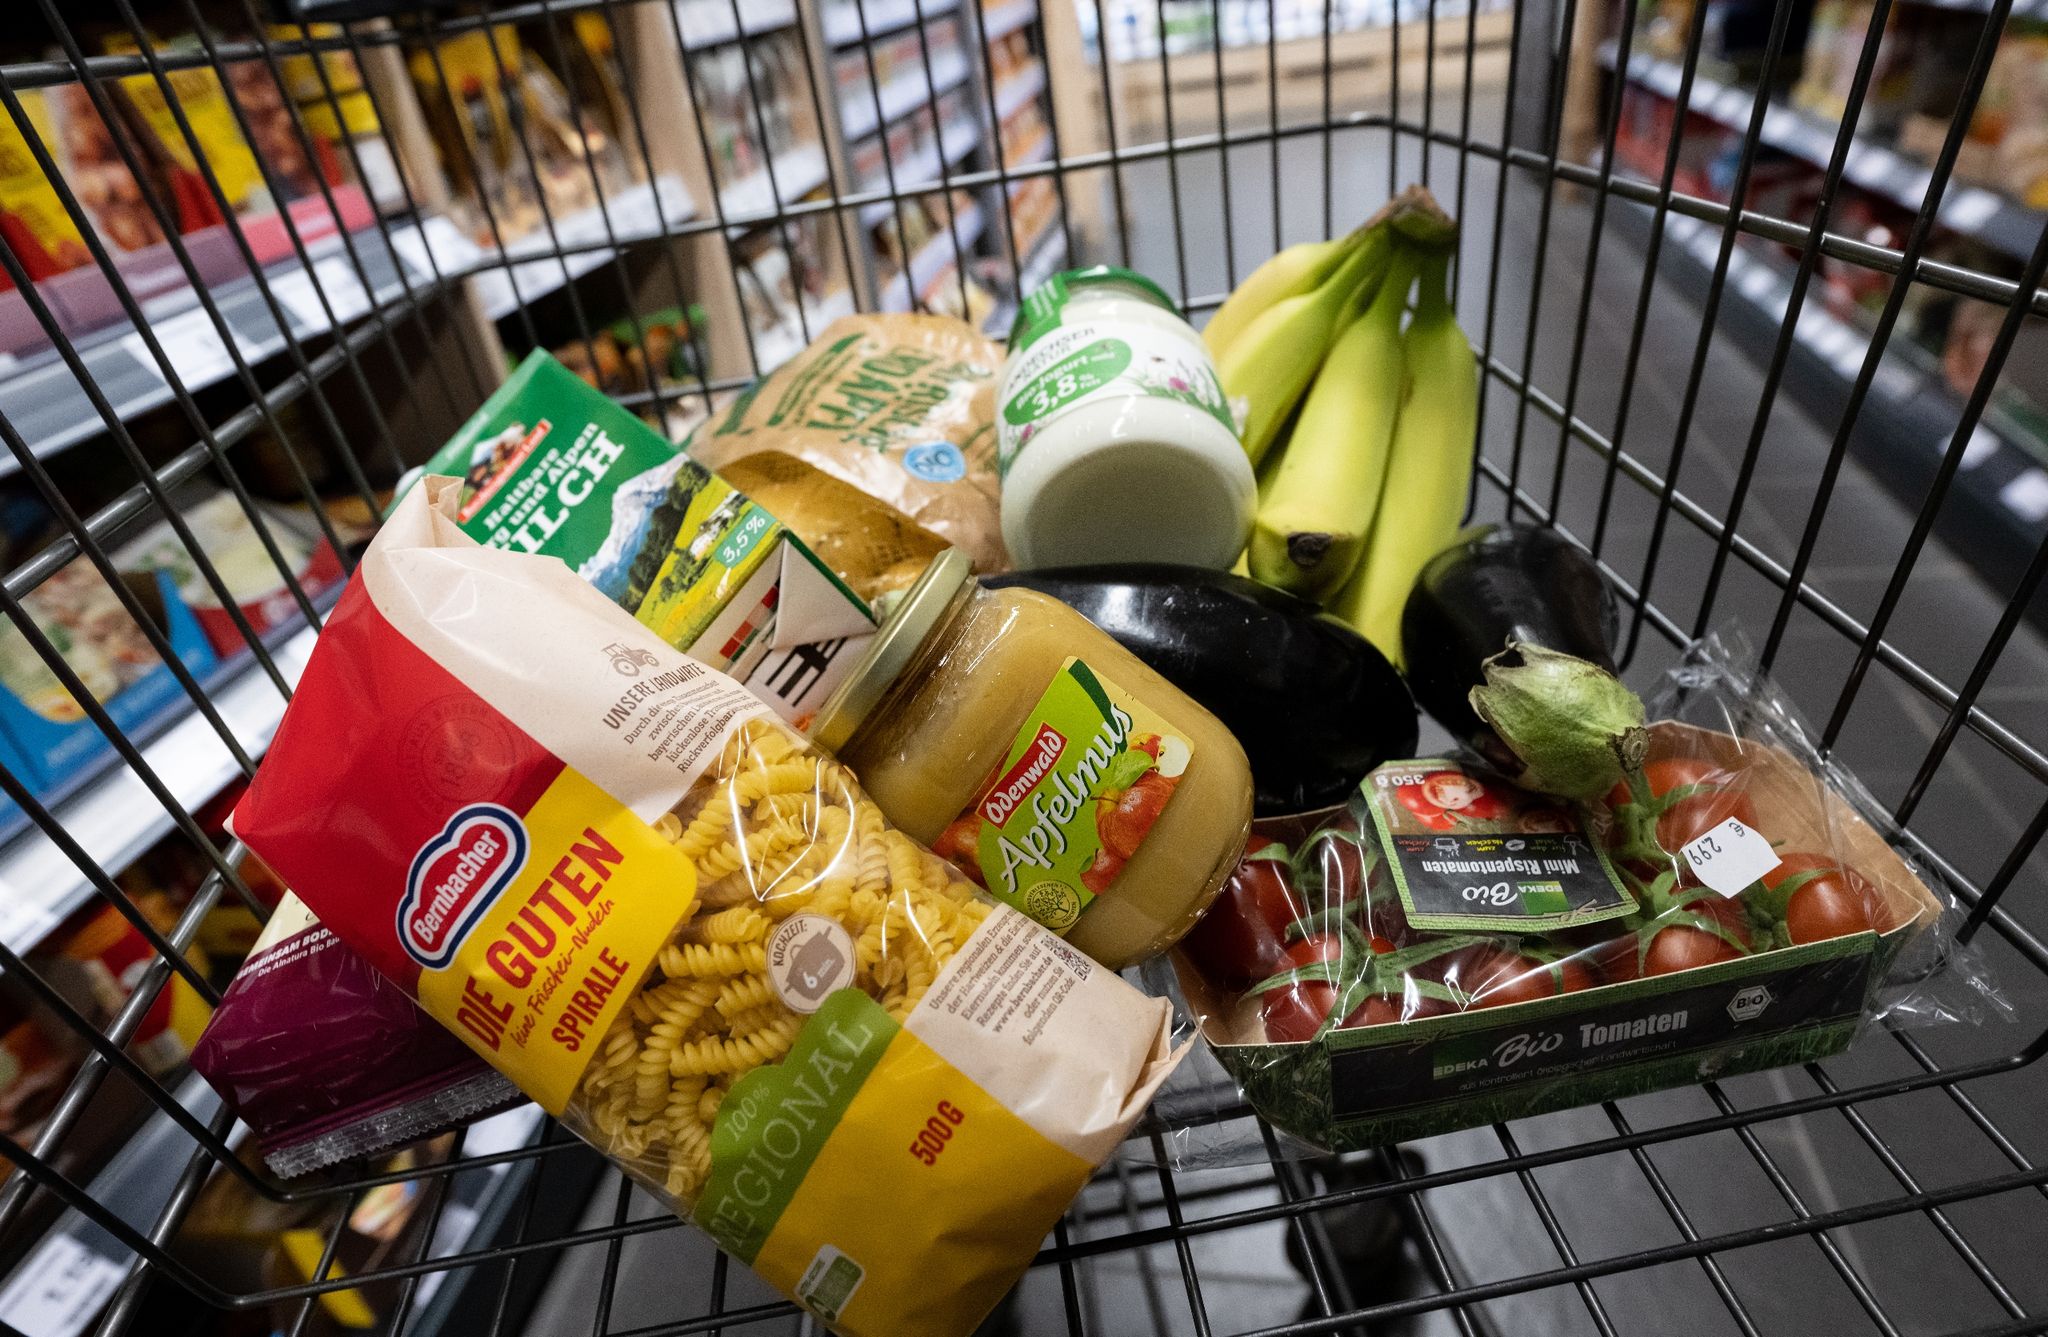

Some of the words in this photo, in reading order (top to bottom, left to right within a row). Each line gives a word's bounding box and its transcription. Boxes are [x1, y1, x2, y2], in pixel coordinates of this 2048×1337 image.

[1032, 374, 1078, 416] 3,8
[482, 448, 560, 531] Haltbare
[501, 430, 625, 553] ILCH
[508, 482, 549, 526] und
[548, 422, 599, 485] Alpen
[602, 681, 655, 730] UNSERE
[650, 662, 706, 692] LANDWIRTE
[623, 717, 651, 745] Durch
[648, 710, 697, 763] bayerischen
[666, 717, 709, 763] lückenlose
[985, 731, 1062, 824] Odenwald
[1000, 703, 1134, 894] Apfelmus
[1391, 774, 1425, 786] 350
[413, 830, 500, 945] Bernbacher
[1422, 857, 1542, 876] Rispentomaten
[1462, 882, 1519, 906] Bio
[1518, 885, 1564, 894] EDEKA
[1543, 859, 1581, 875] Mini
[258, 965, 271, 977] Die
[272, 949, 308, 971] Alnatura
[310, 943, 325, 954] Bio
[302, 927, 333, 947] BOD
[456, 975, 515, 1053] DIE
[486, 826, 624, 989] GUTEN
[527, 898, 615, 1016] Frischei-Nudeln
[771, 921, 809, 968] KOCHZEIT:
[551, 946, 630, 1052] SPIRALE
[803, 968, 820, 990] 6
[928, 973, 960, 1010] Unsere
[956, 937, 992, 980] regionalen
[946, 995, 963, 1015] der
[959, 953, 999, 997] Hartweizen
[996, 944, 1005, 955] &
[1001, 933, 1012, 948] die
[961, 972, 1001, 1021] Eiernudeln
[976, 990, 1008, 1027] Rezepte
[1001, 966, 1025, 992] finden
[1022, 959, 1033, 972] Sie
[1028, 944, 1042, 961] auf
[992, 955, 1054, 1032] www.bernbacher.de
[1024, 998, 1041, 1019] oder
[1055, 965, 1065, 978] Sie
[1022, 1003, 1058, 1046] folgenden
[1433, 1059, 1488, 1079] EDEKA
[1492, 1029, 1564, 1068] Bio
[1579, 1008, 1689, 1049] Tomaten
[724, 1086, 771, 1143] 100%
